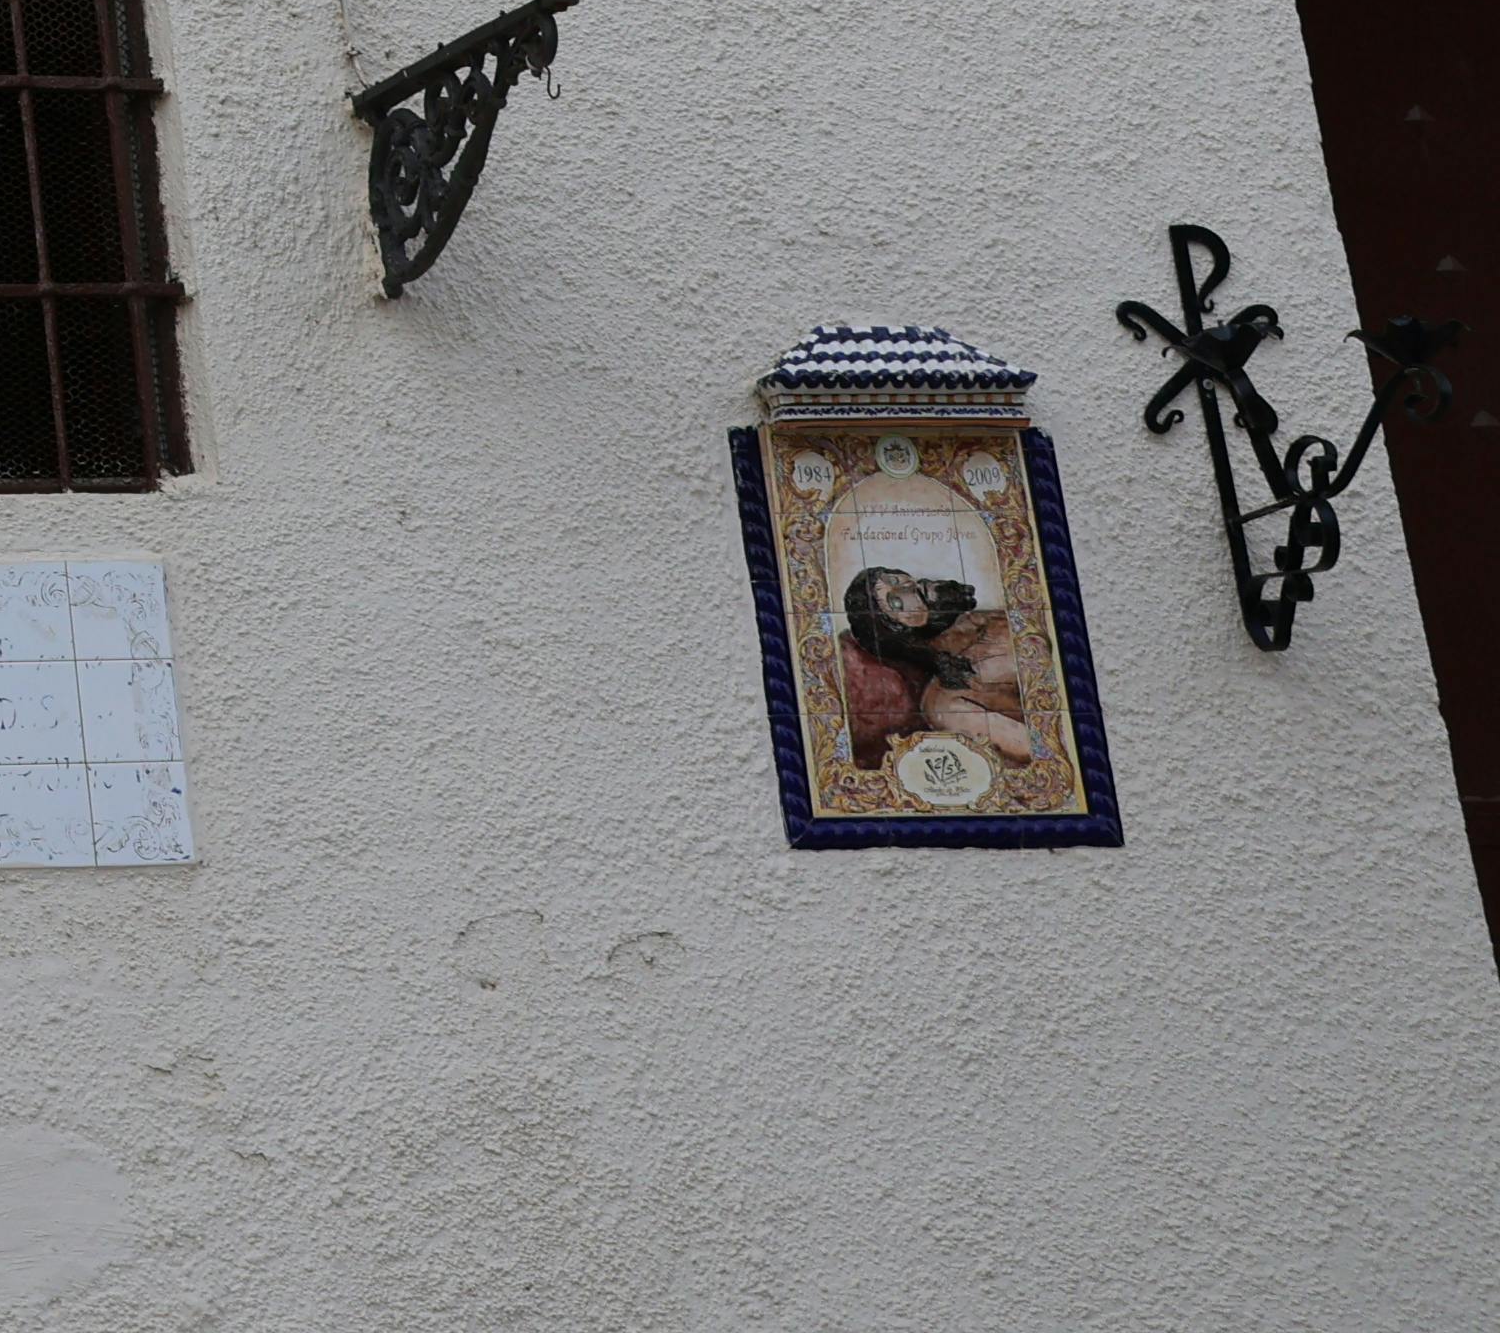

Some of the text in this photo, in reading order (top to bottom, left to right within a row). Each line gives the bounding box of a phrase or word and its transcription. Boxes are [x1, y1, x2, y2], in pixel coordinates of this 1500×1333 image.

[798, 465, 832, 483] 1984
[967, 467, 1000, 486] 2009
[911, 527, 943, 545] Grupo
